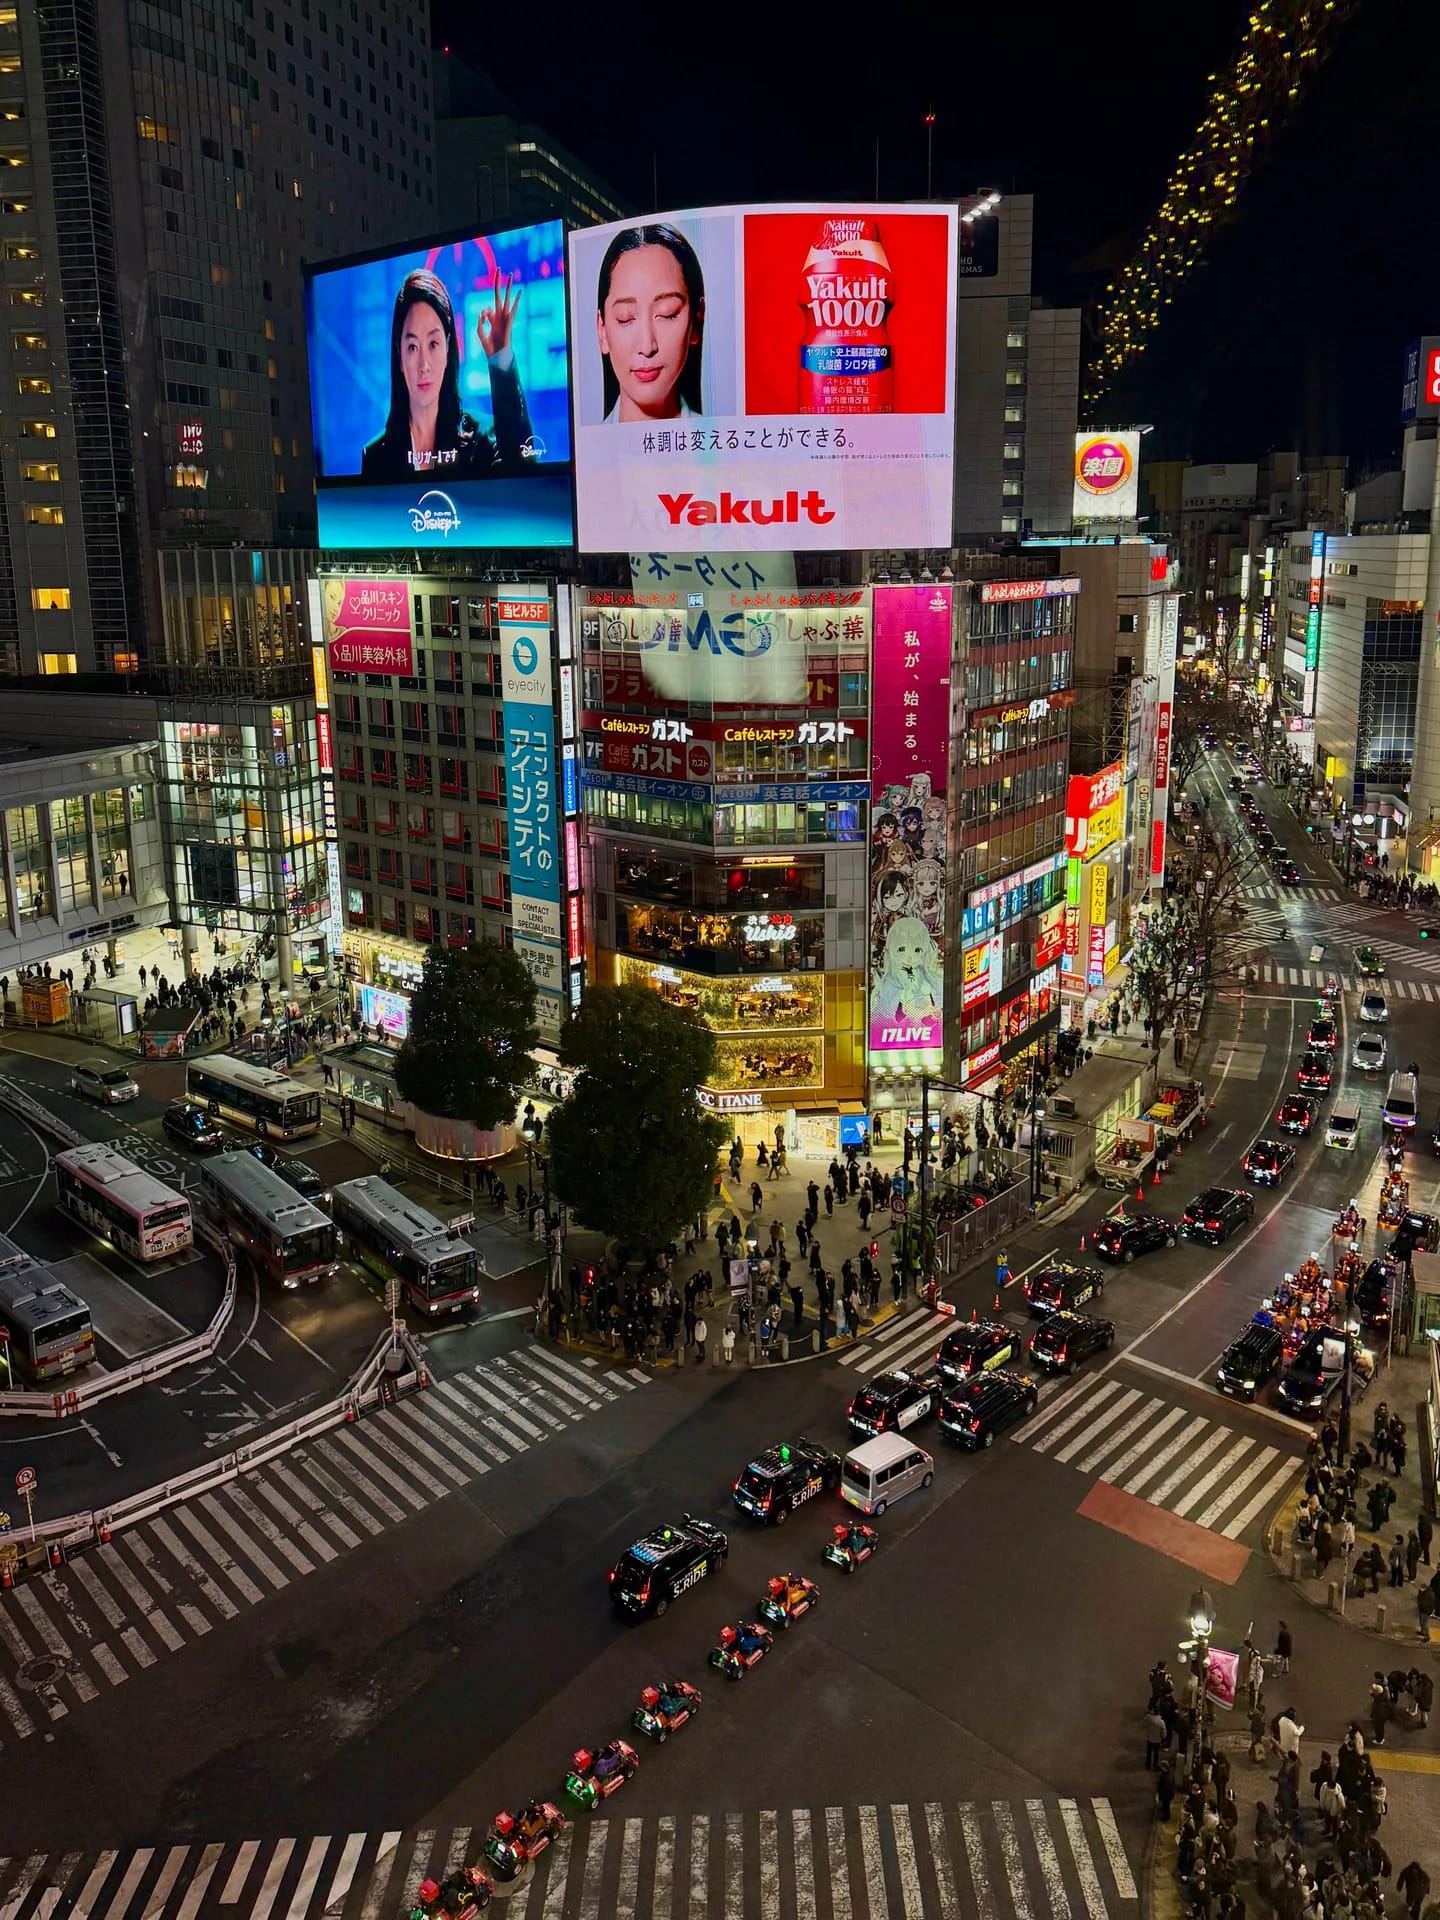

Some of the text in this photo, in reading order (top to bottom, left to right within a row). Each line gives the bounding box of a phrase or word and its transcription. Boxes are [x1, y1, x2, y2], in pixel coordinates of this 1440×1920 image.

[828, 220, 865, 231] Yakult
[806, 276, 888, 299] Yakult
[807, 300, 886, 327] 1000
[807, 347, 888, 357] ヤクルト史上最高密度の
[818, 359, 877, 371] 乳酸菌 シロタ株
[1083, 456, 1124, 477] 楽園
[657, 490, 836, 526] Yakult
[408, 507, 461, 538] Disney+
[360, 590, 404, 604] 品川スキン
[586, 591, 678, 606] しゃぶしゃぶバイキング
[730, 590, 864, 607] しゃぶしゃぶバイキング
[361, 607, 401, 622] クリニック
[503, 604, 544, 619] 当ビル5F
[583, 621, 598, 636] 9F
[788, 615, 864, 641] しゃぶ葉
[1163, 619, 1176, 670] CAMERA
[340, 646, 407, 667] 品川美容外科
[507, 679, 546, 697] eyecity
[904, 630, 920, 760] 私が、始まる。
[651, 719, 694, 743] ガスト
[798, 722, 854, 744] ガスト
[586, 742, 604, 758] 7F
[608, 744, 630, 757] Café
[632, 744, 682, 773] ガスト
[1157, 736, 1169, 779] TaxFree
[615, 776, 688, 796] 英会話イーオン
[764, 785, 867, 801] 英会話イーオン
[510, 729, 534, 867] アイシティ
[533, 731, 553, 871] コンタクトの
[521, 903, 549, 916] CONTACT
[528, 913, 544, 923] LENS
[517, 919, 555, 935] SPECIALISTS
[1029, 963, 1057, 995] LUSH
[881, 1026, 932, 1043] 17LIVE
[916, 1403, 928, 1417] GO
[791, 1481, 823, 1510] S.RIDE
[672, 1566, 708, 1598] S.RIDE
